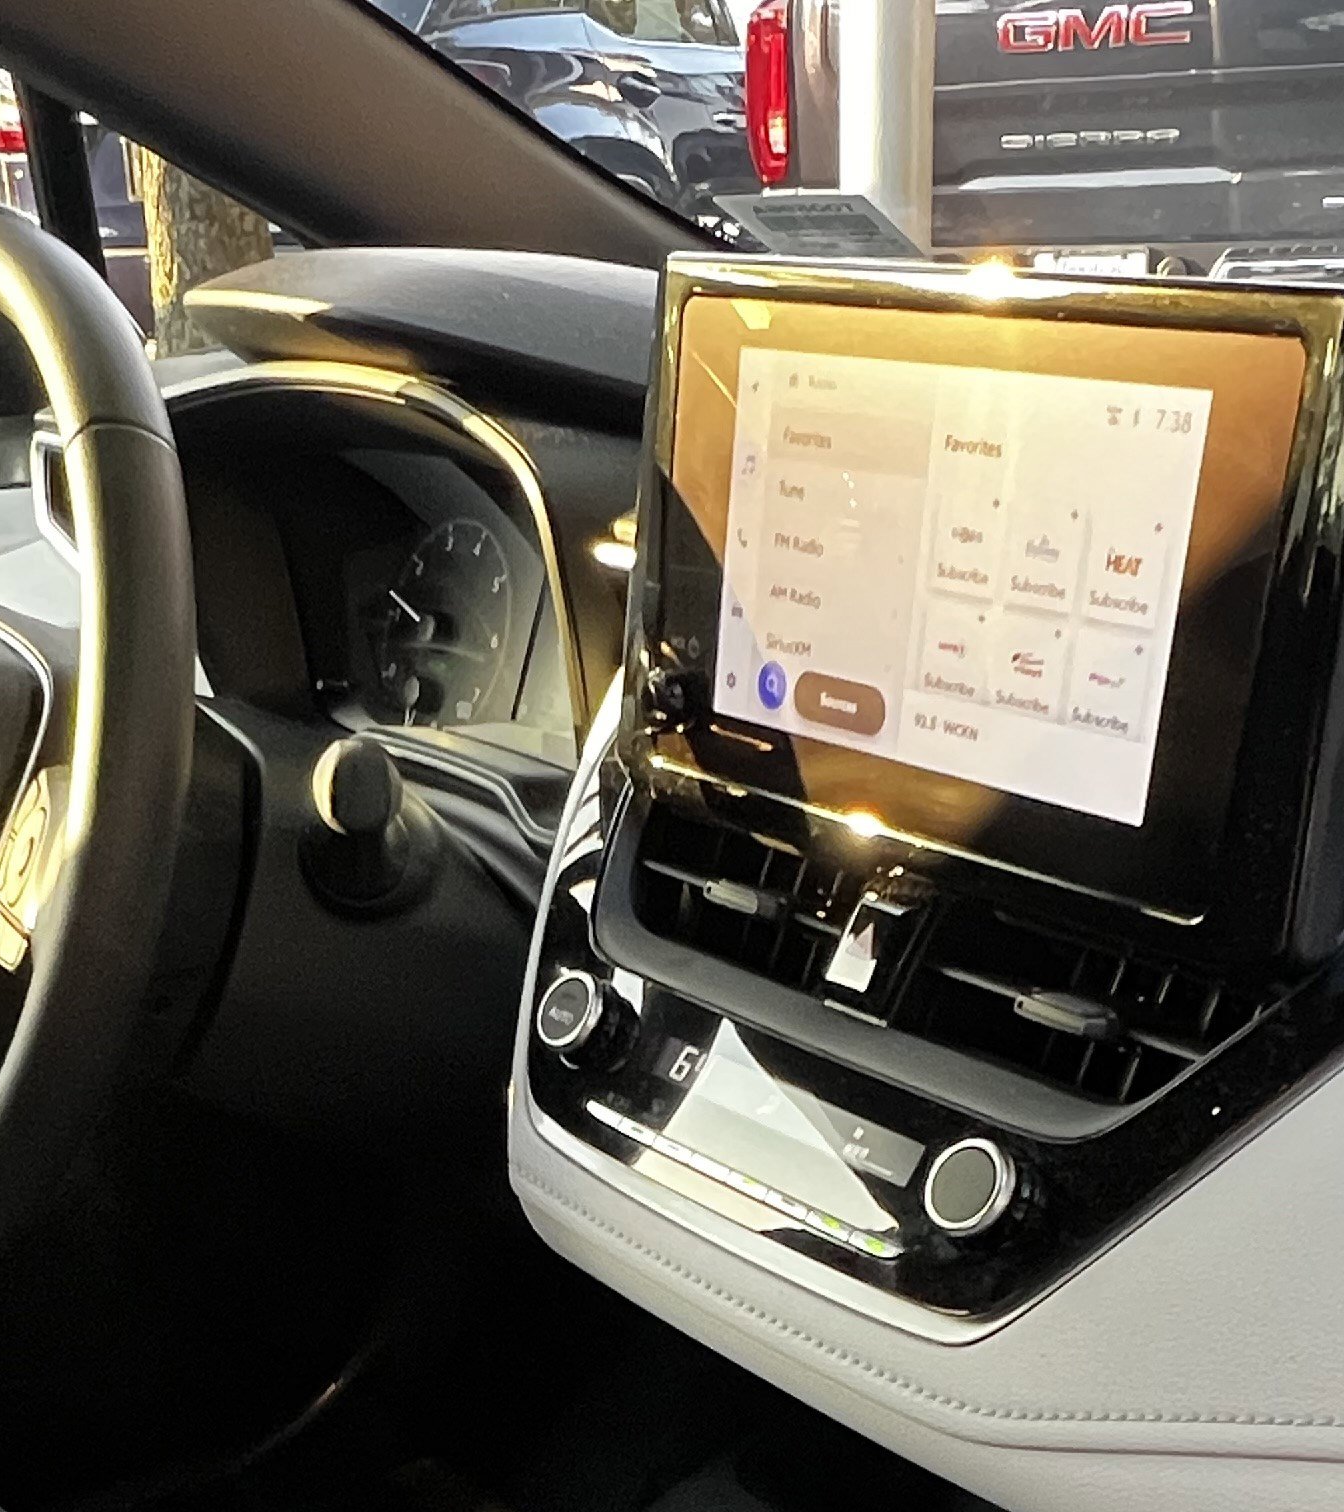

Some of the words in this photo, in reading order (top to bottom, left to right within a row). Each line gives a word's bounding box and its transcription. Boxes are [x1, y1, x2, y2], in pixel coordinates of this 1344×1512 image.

[996, 1, 1194, 54] GMC
[1000, 128, 1180, 149] SIERRA
[944, 433, 1003, 458] Favorites
[936, 561, 990, 585] Subscribe
[1105, 553, 1143, 577] HEAT
[1010, 574, 1066, 601] Subscribe
[1089, 589, 1149, 616] Subscribe
[923, 671, 977, 698] Subscribe
[995, 689, 1050, 715] Subscribe
[1071, 705, 1129, 735] Subscribe
